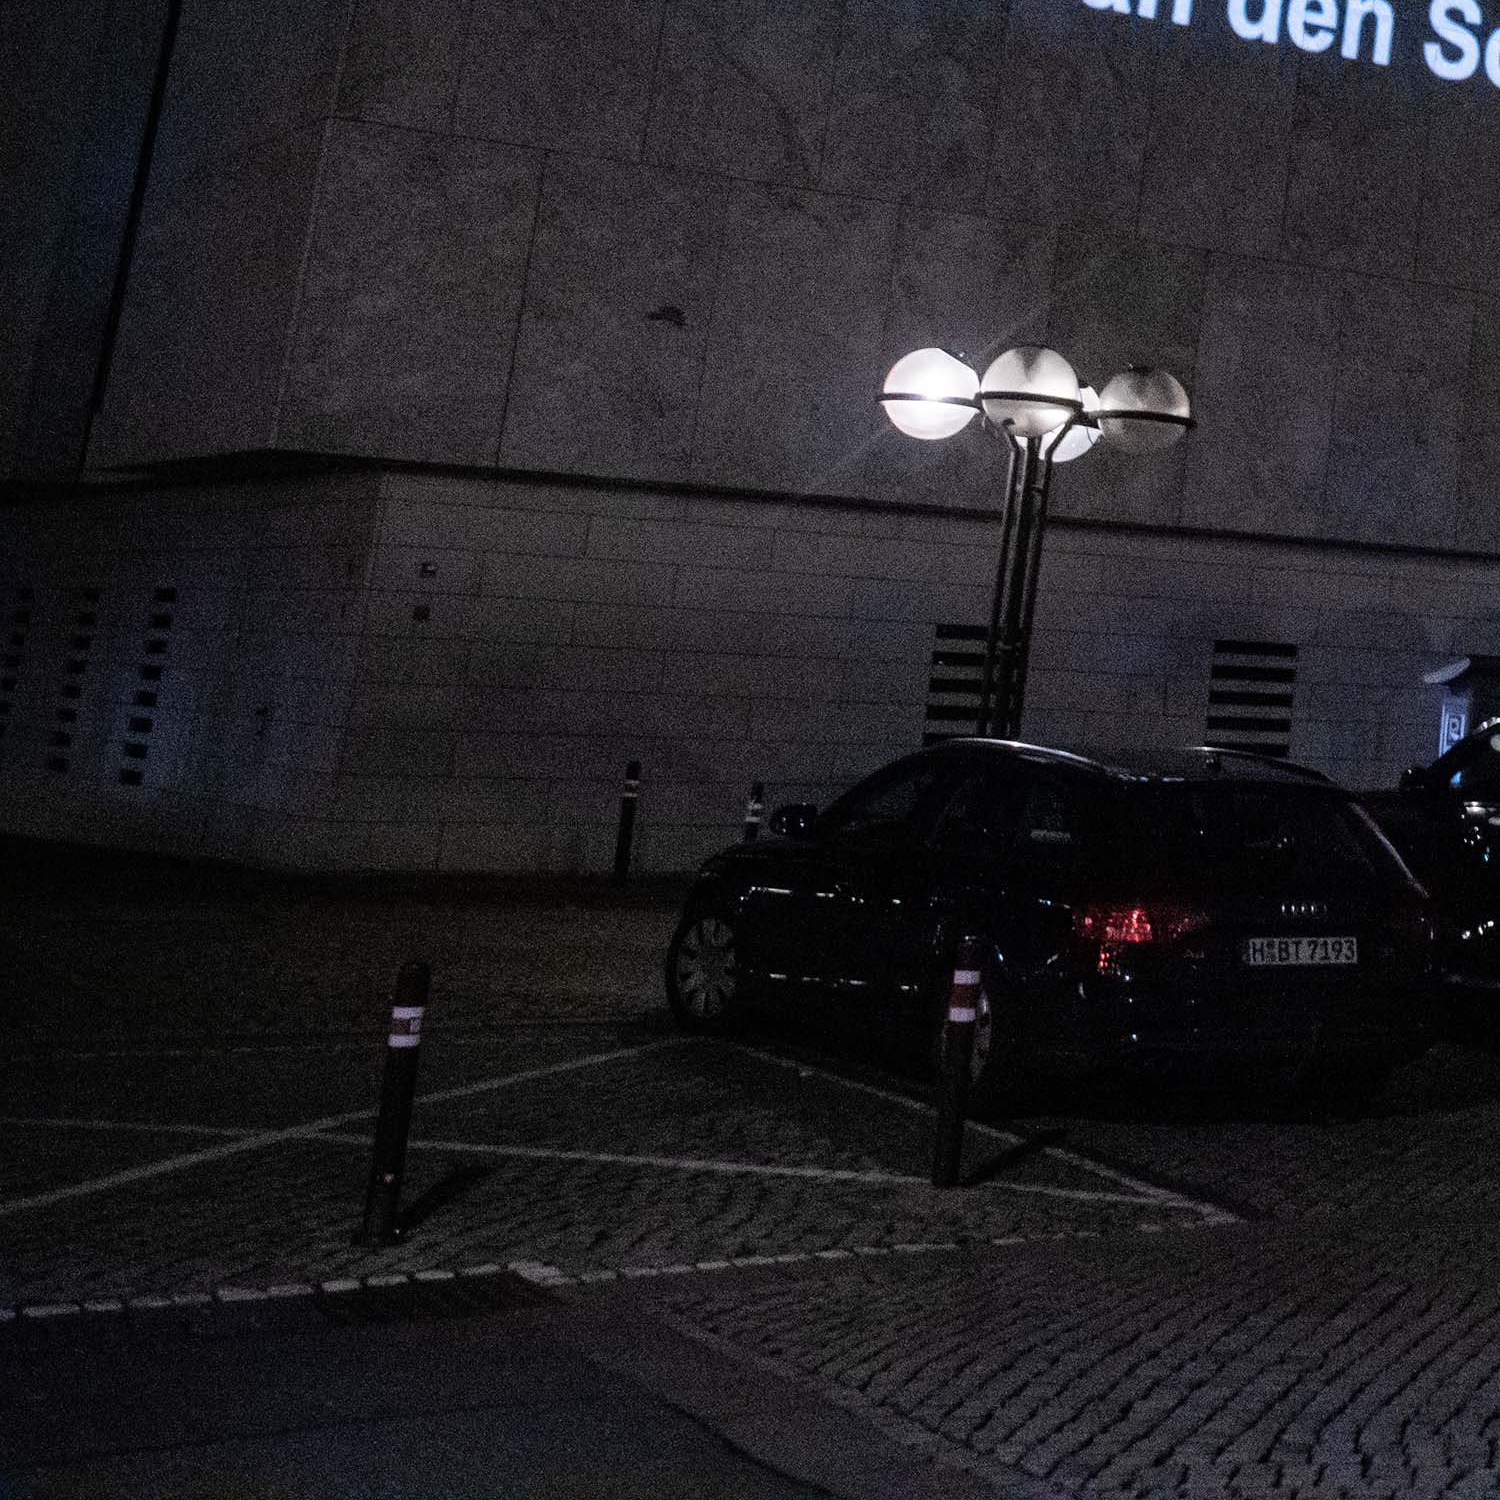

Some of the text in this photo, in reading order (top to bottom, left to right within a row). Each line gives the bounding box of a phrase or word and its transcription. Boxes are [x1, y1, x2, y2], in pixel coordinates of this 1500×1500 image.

[1251, 940, 1356, 962] H BT 7193
